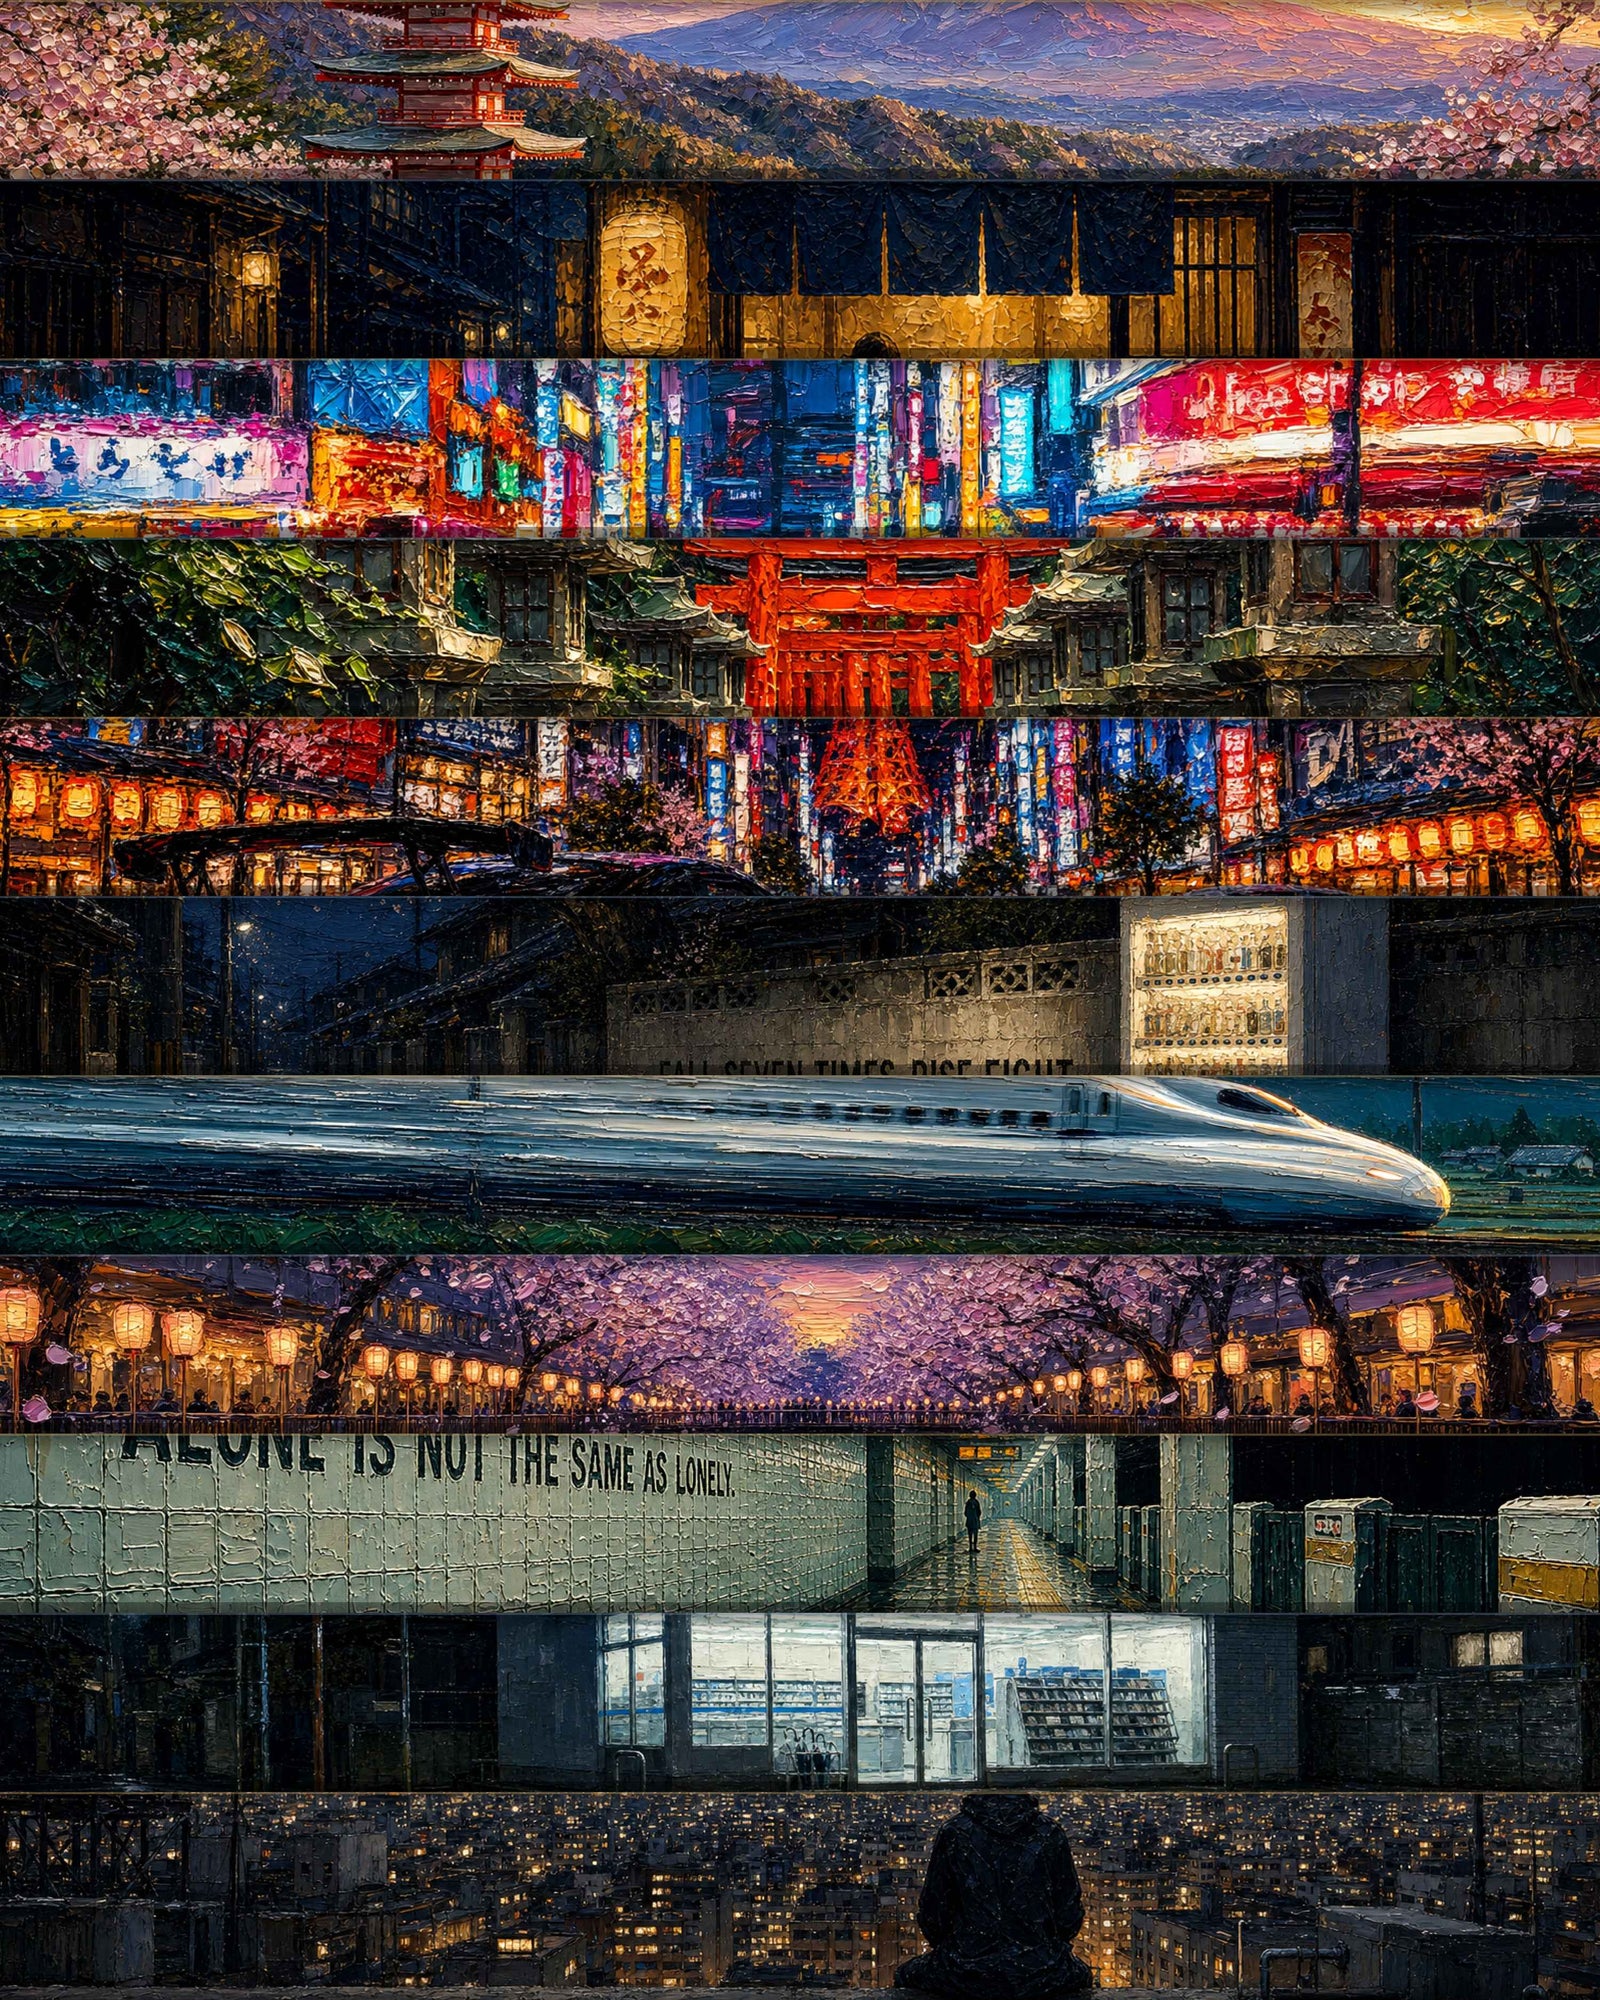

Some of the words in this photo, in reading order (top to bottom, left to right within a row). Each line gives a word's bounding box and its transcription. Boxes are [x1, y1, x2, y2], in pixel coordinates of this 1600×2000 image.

[506, 1434, 560, 1486] THE
[571, 1438, 634, 1489] SAME
[643, 1450, 668, 1494] AS
[676, 1454, 736, 1497] LONELY.
